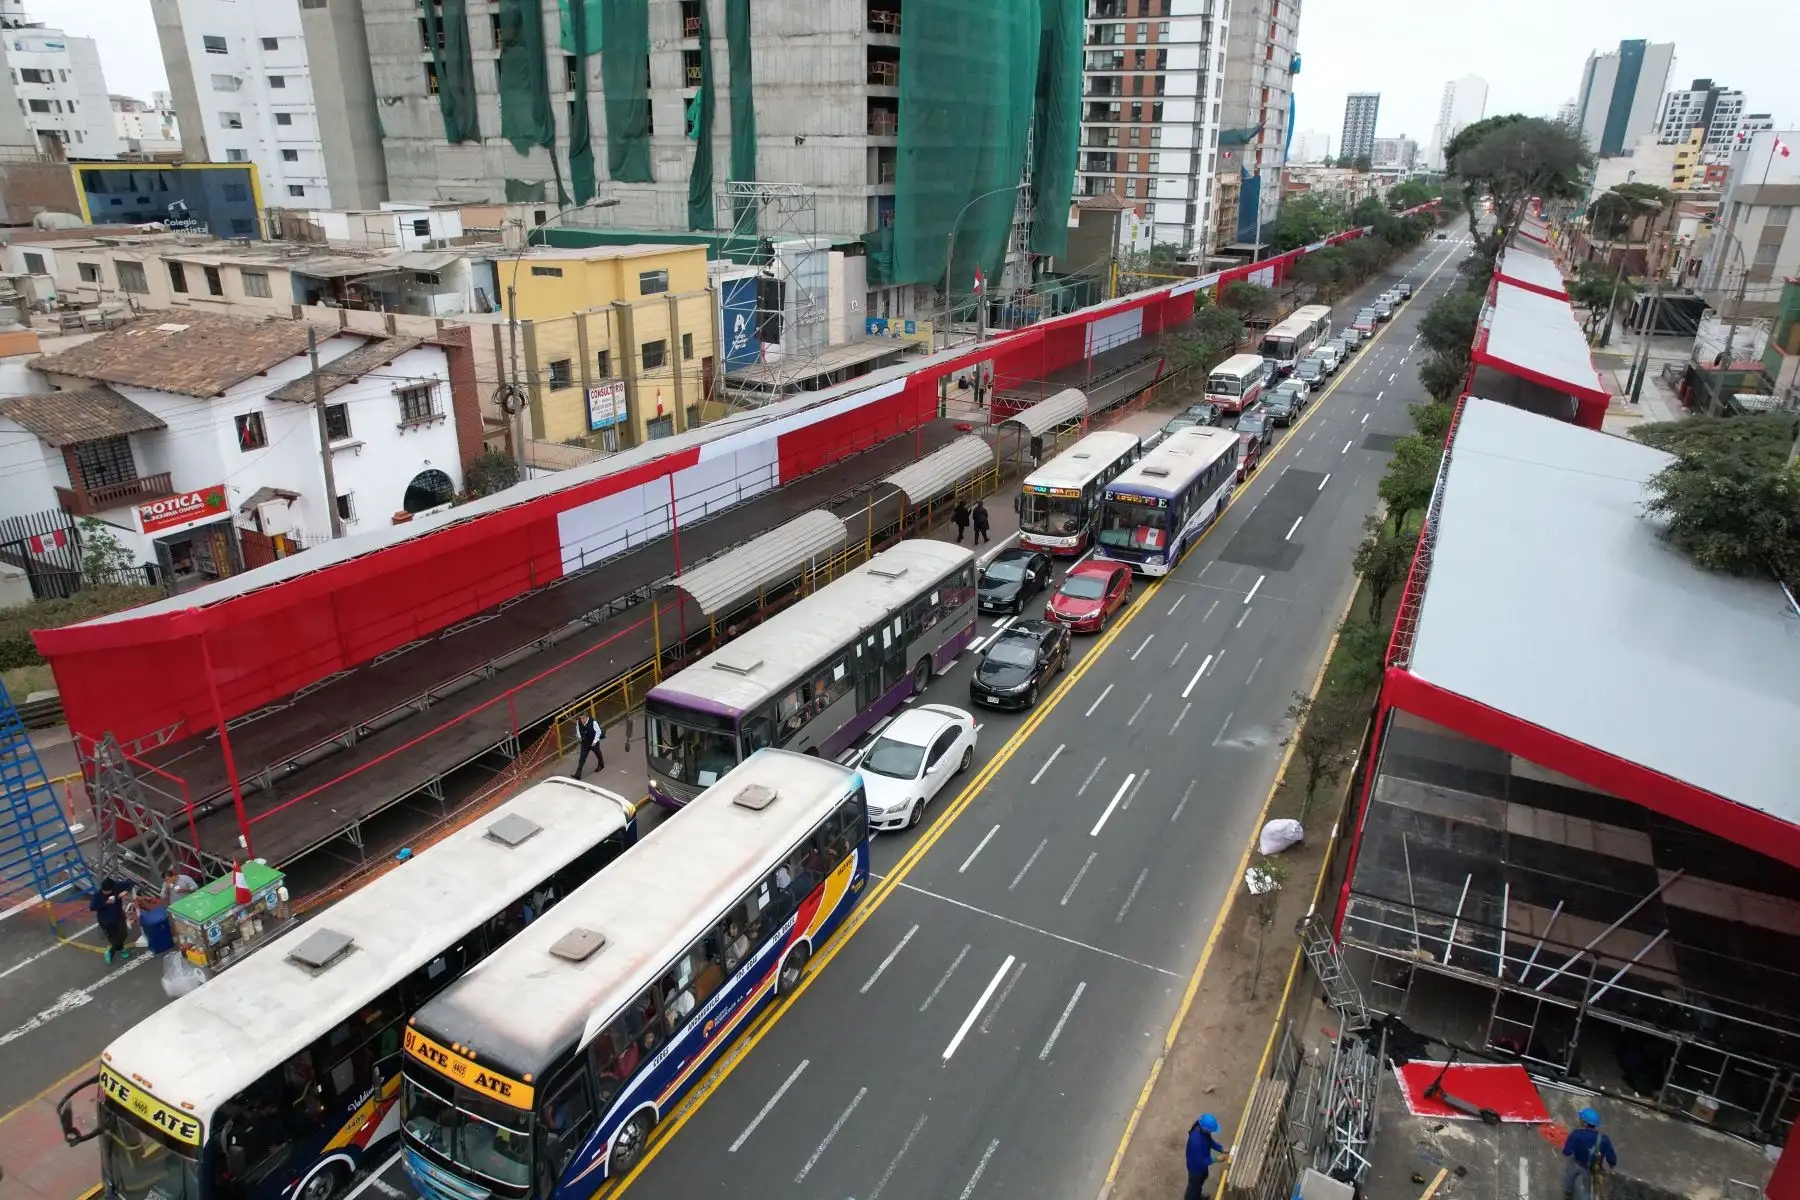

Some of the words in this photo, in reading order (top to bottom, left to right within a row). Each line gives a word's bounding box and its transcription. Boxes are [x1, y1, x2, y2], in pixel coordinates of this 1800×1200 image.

[164, 218, 197, 227] Colegio
[591, 383, 624, 399] CONSULTRIO
[143, 492, 202, 516] BOTICA
[1104, 491, 1114, 501] E
[1158, 498, 1168, 508] E
[418, 1043, 449, 1068] ATE
[475, 1071, 512, 1097] ATE
[100, 1071, 130, 1102] ATE
[153, 1109, 197, 1139] ATE
